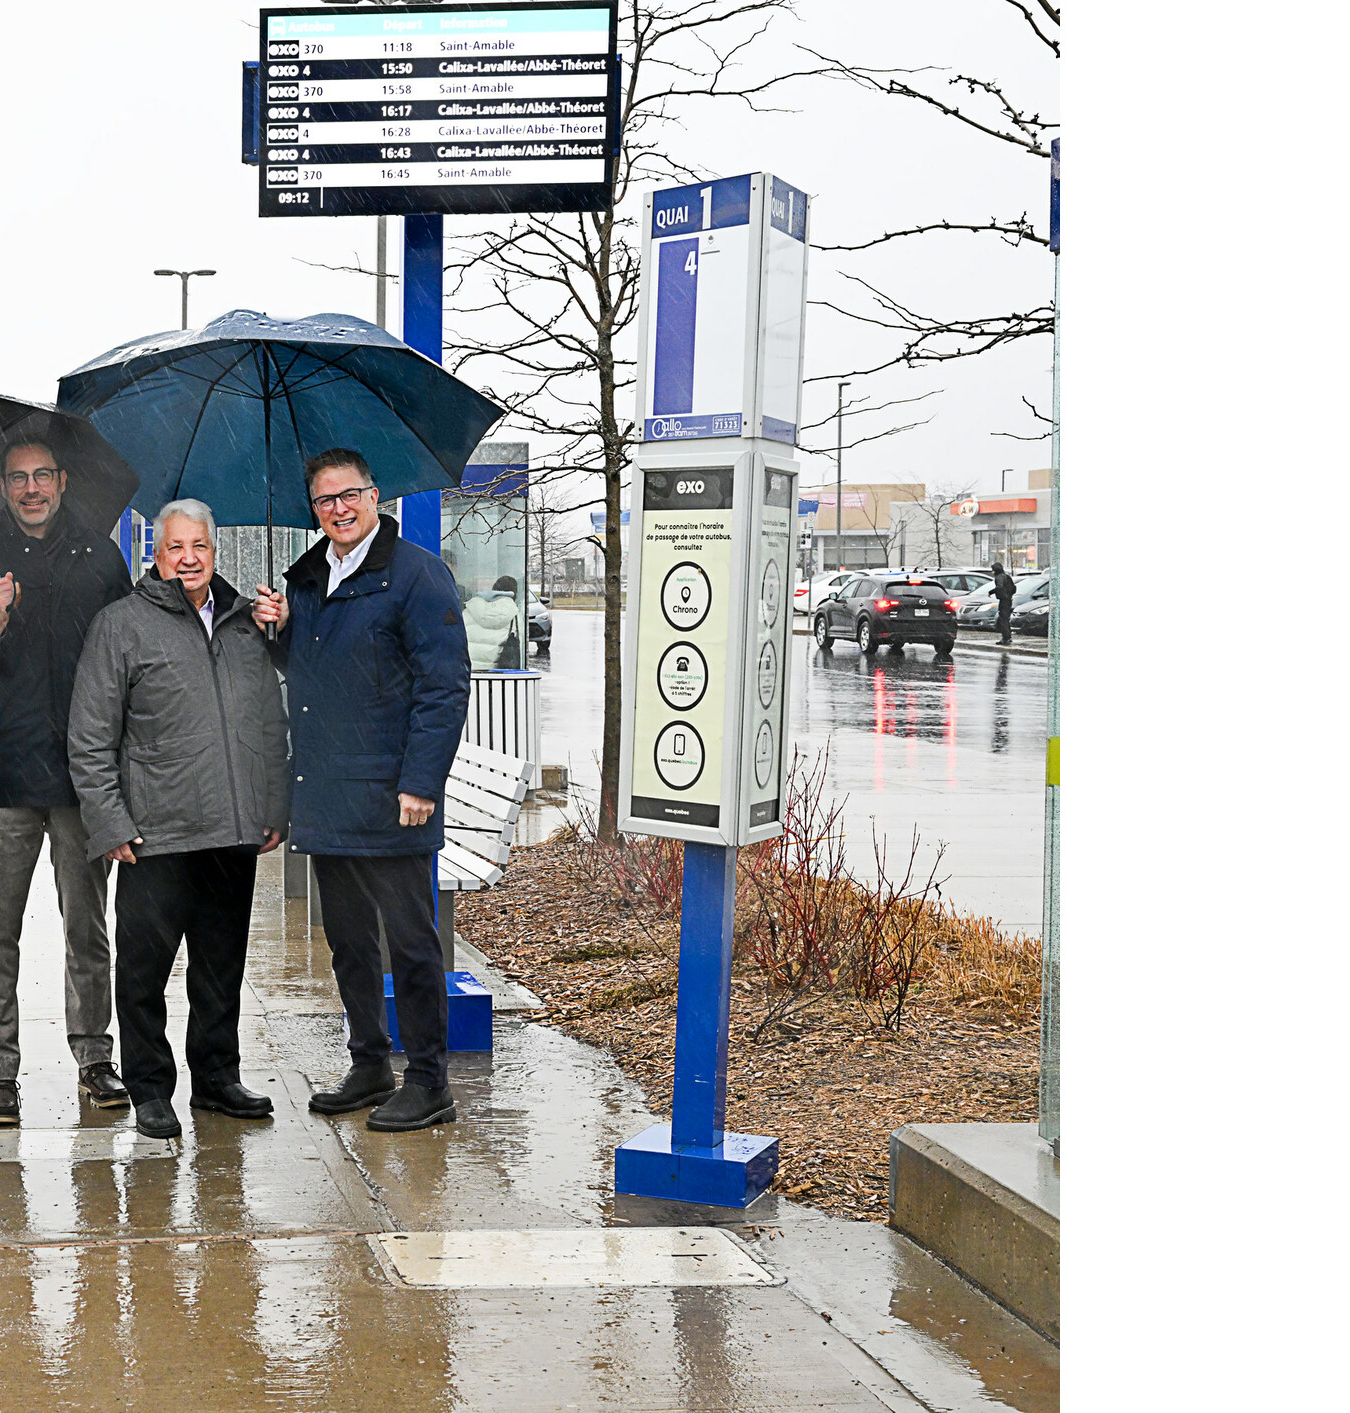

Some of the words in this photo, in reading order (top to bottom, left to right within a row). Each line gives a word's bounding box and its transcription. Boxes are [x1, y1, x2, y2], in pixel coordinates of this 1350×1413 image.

[288, 20, 336, 32] Autobus
[383, 18, 422, 31] Départ
[440, 16, 508, 29] Information
[304, 45, 324, 54] 370
[383, 42, 412, 52] 11:18
[440, 40, 515, 51] Saint-Amable
[302, 65, 310, 76] 4
[382, 63, 413, 74] 15:50
[439, 59, 606, 73] Calixa-Lavallée/Abbé-Théoret
[304, 87, 323, 96] 370
[382, 85, 412, 94] 15:58
[439, 83, 514, 94] Saint-Amable
[302, 107, 310, 118] 4
[381, 105, 413, 117] 16:17
[438, 102, 605, 116] Calixa-Lavallée/Abbé-Théoret
[303, 129, 309, 138] 4
[382, 127, 411, 137] 16:28
[438, 124, 603, 136] Calixa-Lavallée/Abbé-Théoret
[302, 149, 310, 160] 4
[381, 147, 411, 158] 16:43
[437, 144, 603, 158] Calixa-Lavallée/Abbé-Théoret
[303, 171, 322, 180] 370
[381, 169, 410, 178] 16:45
[437, 167, 512, 178] Saint-Amable
[278, 192, 309, 203] 09:12
[657, 205, 688, 229] QUAI
[700, 186, 712, 230] 1
[772, 197, 784, 219] QUAI
[789, 192, 793, 233] 1
[684, 251, 697, 275] 4
[677, 480, 704, 494] exo
[655, 535, 679, 543] passage
[673, 605, 698, 613] Chrono
